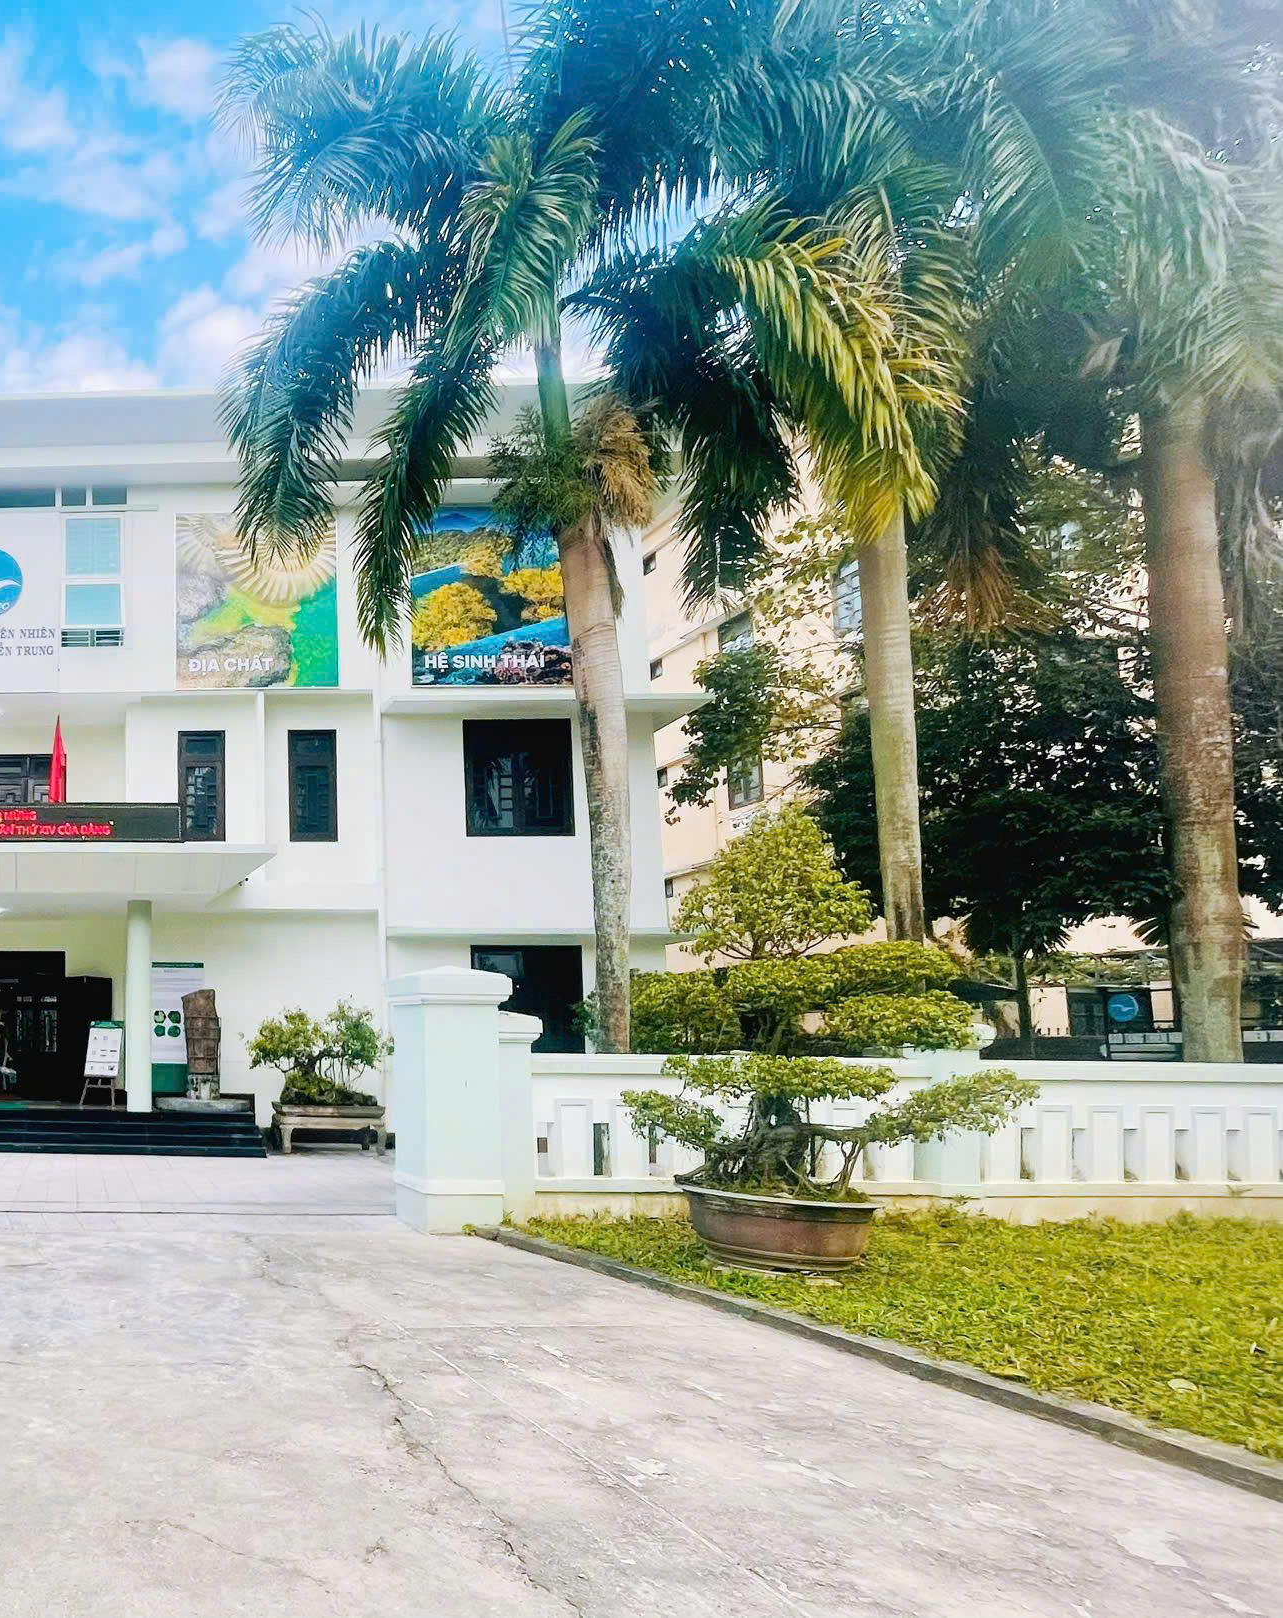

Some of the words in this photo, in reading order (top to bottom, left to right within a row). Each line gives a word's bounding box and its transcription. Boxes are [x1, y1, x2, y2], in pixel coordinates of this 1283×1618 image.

[20, 627, 56, 639] NHIÊN
[16, 645, 54, 656] TRUNG
[188, 658, 220, 676] ĐỊA
[224, 652, 273, 672] CHẤT
[424, 651, 449, 673] HỆ
[452, 654, 497, 669] SINH
[500, 650, 545, 668] THÁI
